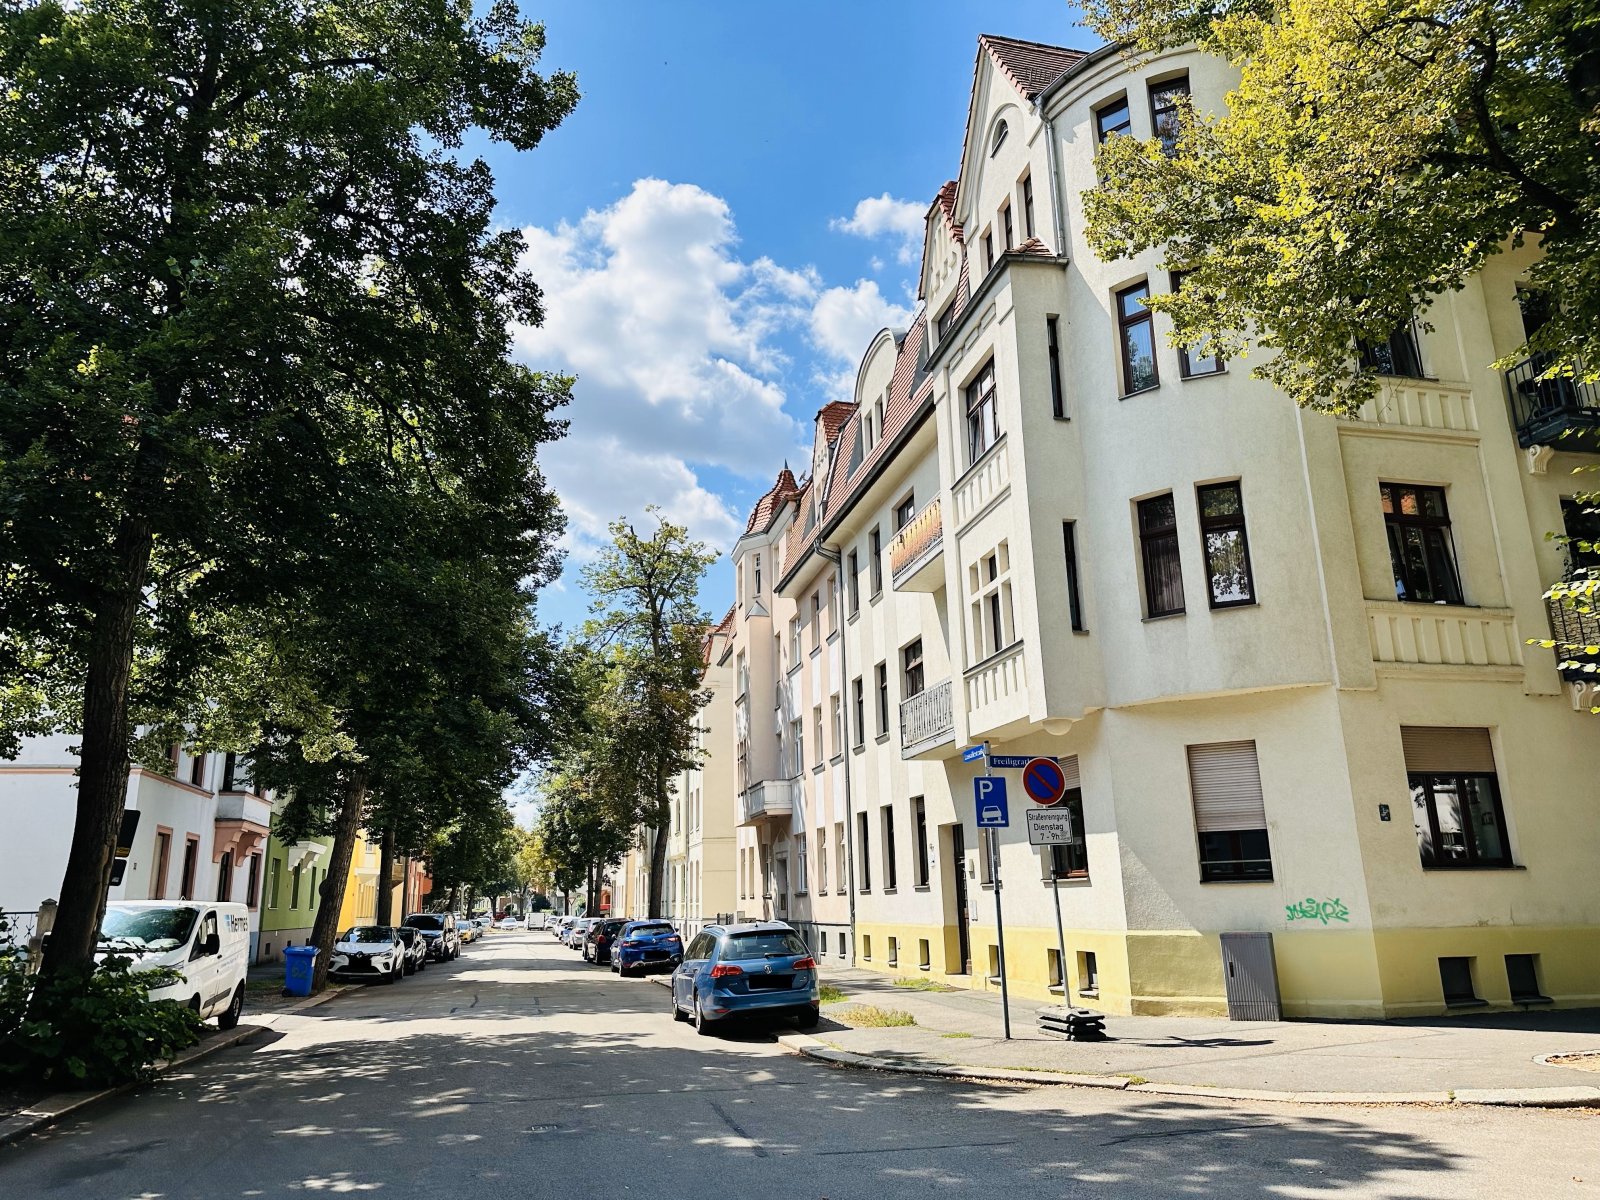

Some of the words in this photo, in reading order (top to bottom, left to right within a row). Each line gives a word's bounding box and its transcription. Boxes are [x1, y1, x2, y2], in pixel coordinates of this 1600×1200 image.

[979, 780, 993, 800] P
[1028, 813, 1068, 822] Straßenreinigung
[1033, 823, 1064, 831] Dienstag
[1040, 832, 1045, 841] 7
